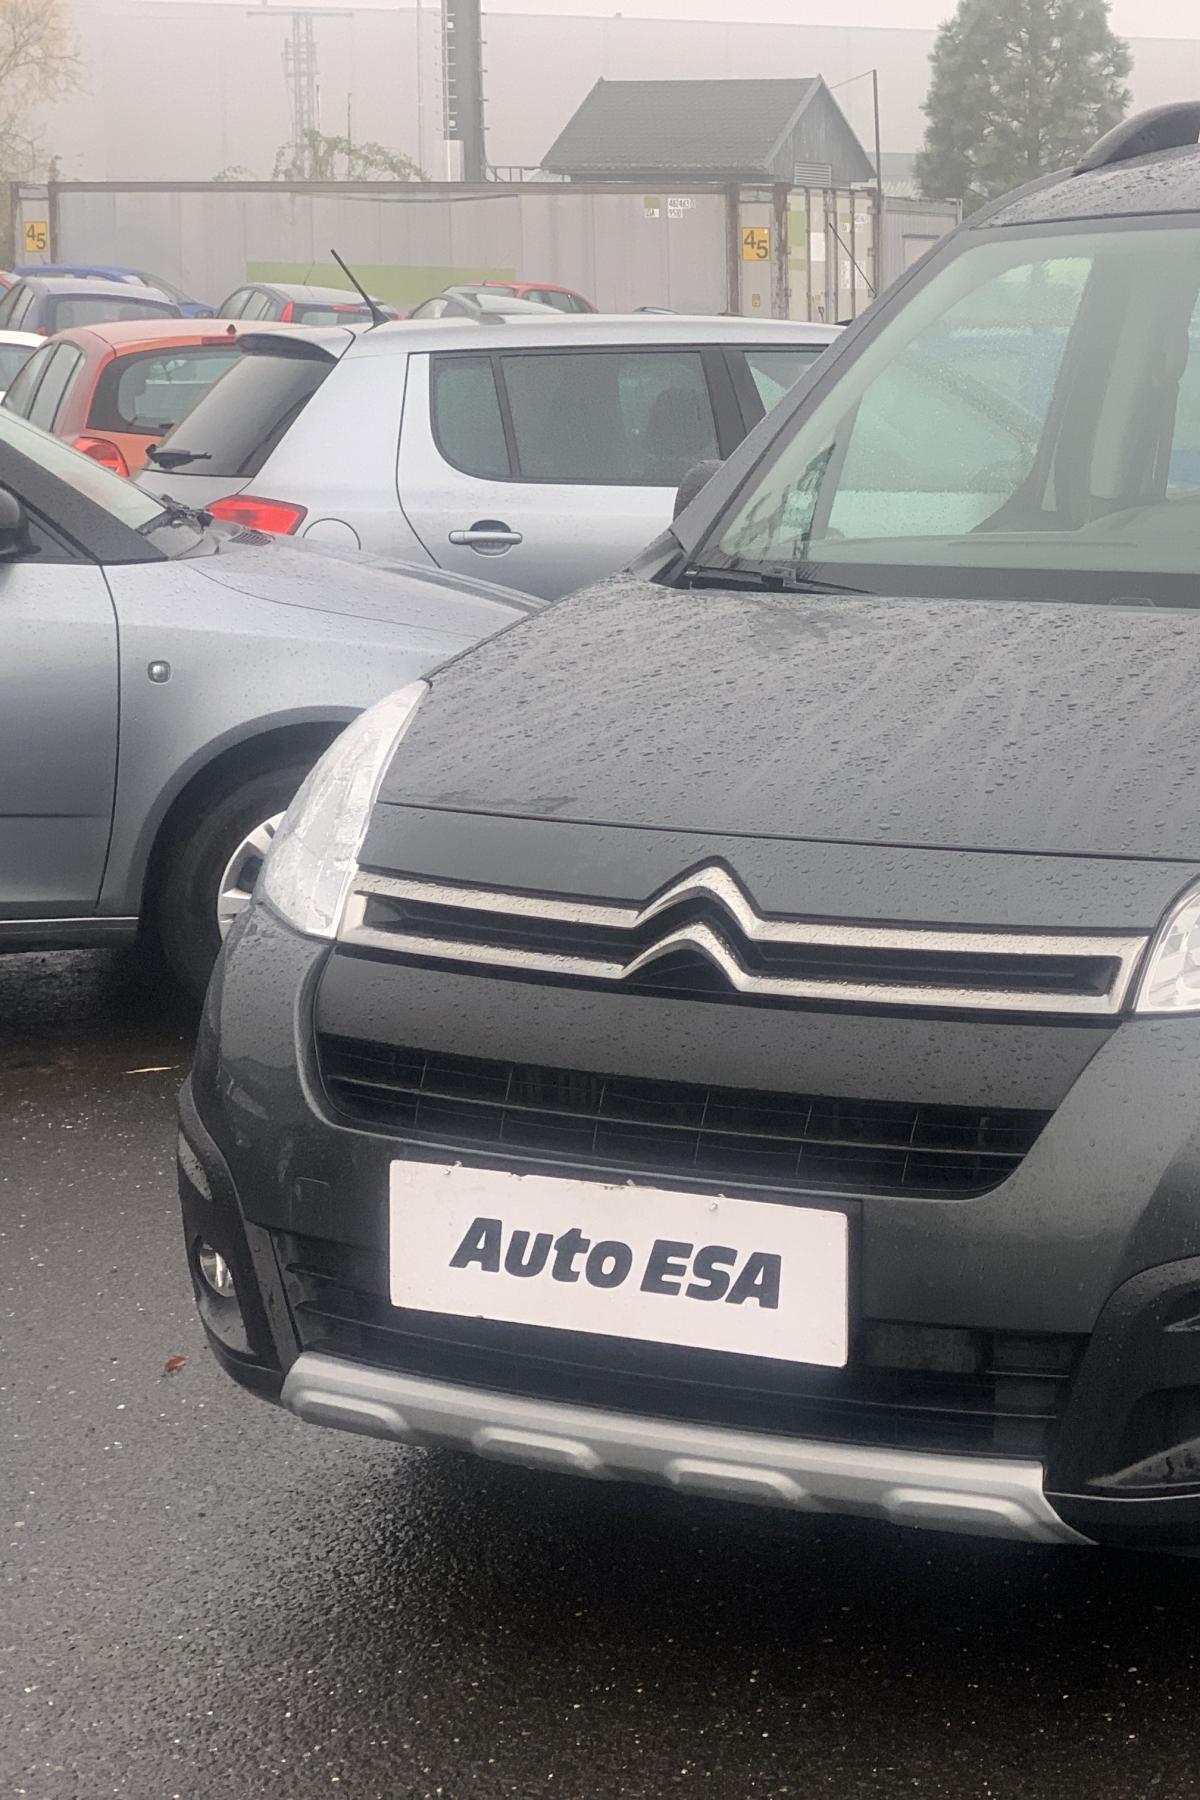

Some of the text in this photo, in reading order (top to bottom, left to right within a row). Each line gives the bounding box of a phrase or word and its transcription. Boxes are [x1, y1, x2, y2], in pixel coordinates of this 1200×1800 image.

[26, 224, 46, 250] 45
[744, 230, 768, 259] 45
[449, 1217, 782, 1310] Auto ESA
